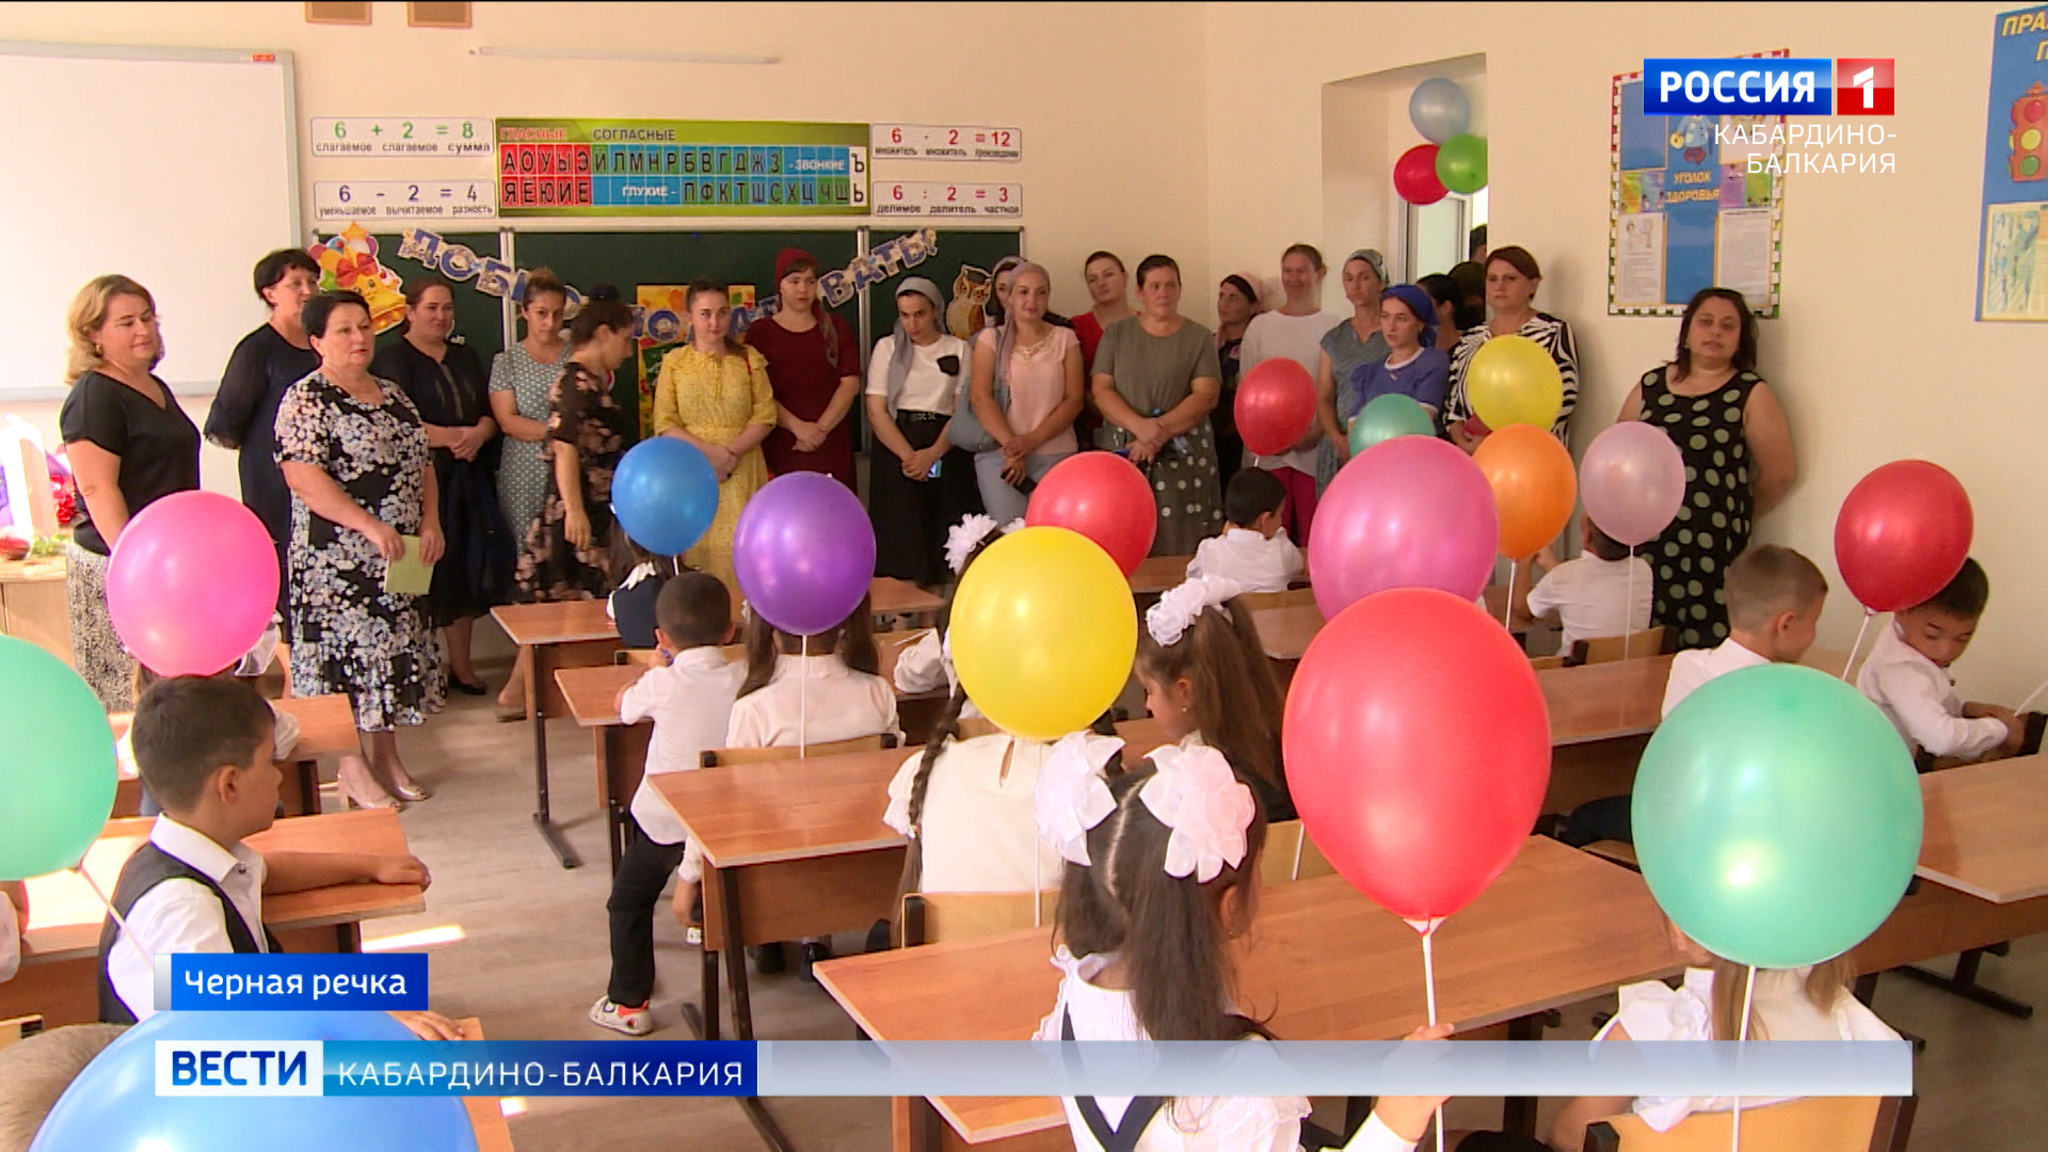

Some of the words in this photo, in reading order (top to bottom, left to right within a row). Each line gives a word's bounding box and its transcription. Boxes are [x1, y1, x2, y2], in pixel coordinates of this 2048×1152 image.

[2001, 9, 2048, 37] ПРА
[333, 121, 347, 140] 6
[402, 121, 415, 140] 2
[461, 121, 475, 140] 8
[499, 126, 567, 141] ГЛАСНЫЕ
[593, 127, 675, 141] СОГЛАСНЫЕ
[891, 127, 902, 144] 6
[948, 129, 959, 146] 2
[991, 131, 1012, 147] 12
[316, 142, 373, 153] слагаемое
[382, 142, 439, 153] слагаемое
[447, 143, 491, 156] сумма
[1673, 171, 1711, 184] УГОЛОК
[339, 184, 352, 204] 6
[407, 184, 420, 203] 2
[467, 184, 478, 203] 4
[621, 185, 670, 198] ГЛУХИЕ
[892, 184, 903, 201] 6
[946, 186, 958, 203] 2
[998, 187, 1009, 204] 3
[1666, 188, 1720, 203] ЗДОРОВЬЯ
[319, 205, 378, 218] уменьшаемое
[385, 205, 444, 216] вычитаемое
[452, 205, 494, 217] разность
[876, 203, 922, 214] делимое
[929, 204, 977, 214] делитель
[984, 204, 1020, 215] частное
